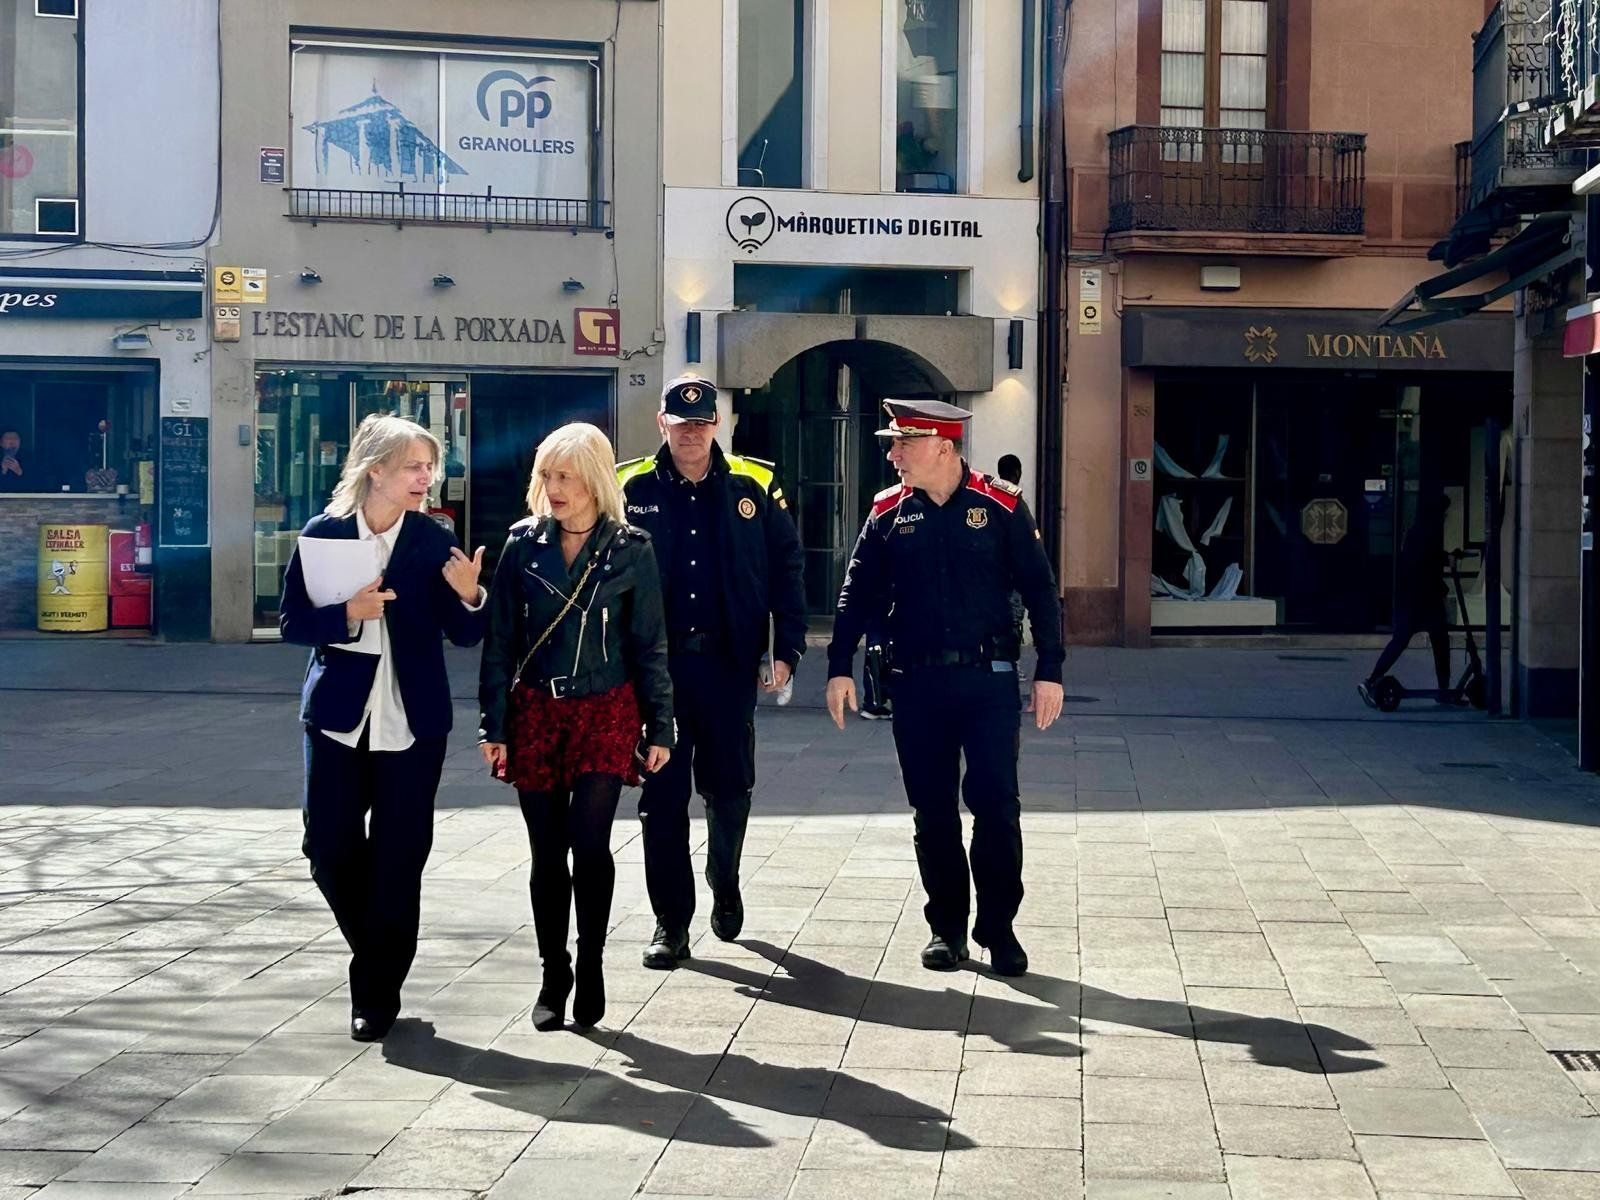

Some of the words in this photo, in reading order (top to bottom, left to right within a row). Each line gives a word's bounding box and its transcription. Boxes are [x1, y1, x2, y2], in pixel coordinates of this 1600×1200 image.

[458, 136, 575, 155] GRANOLLERS
[776, 212, 903, 235] MÀRQUETING
[908, 219, 983, 238] DIGITAL
[175, 327, 196, 342] 32
[252, 311, 364, 338] L'ESTANC
[374, 314, 405, 340] DE
[414, 315, 445, 341] LA
[454, 317, 566, 344] PORXADA
[1306, 332, 1448, 359] MONTAÑA
[629, 374, 646, 386] 33
[47, 529, 81, 540] SALSA
